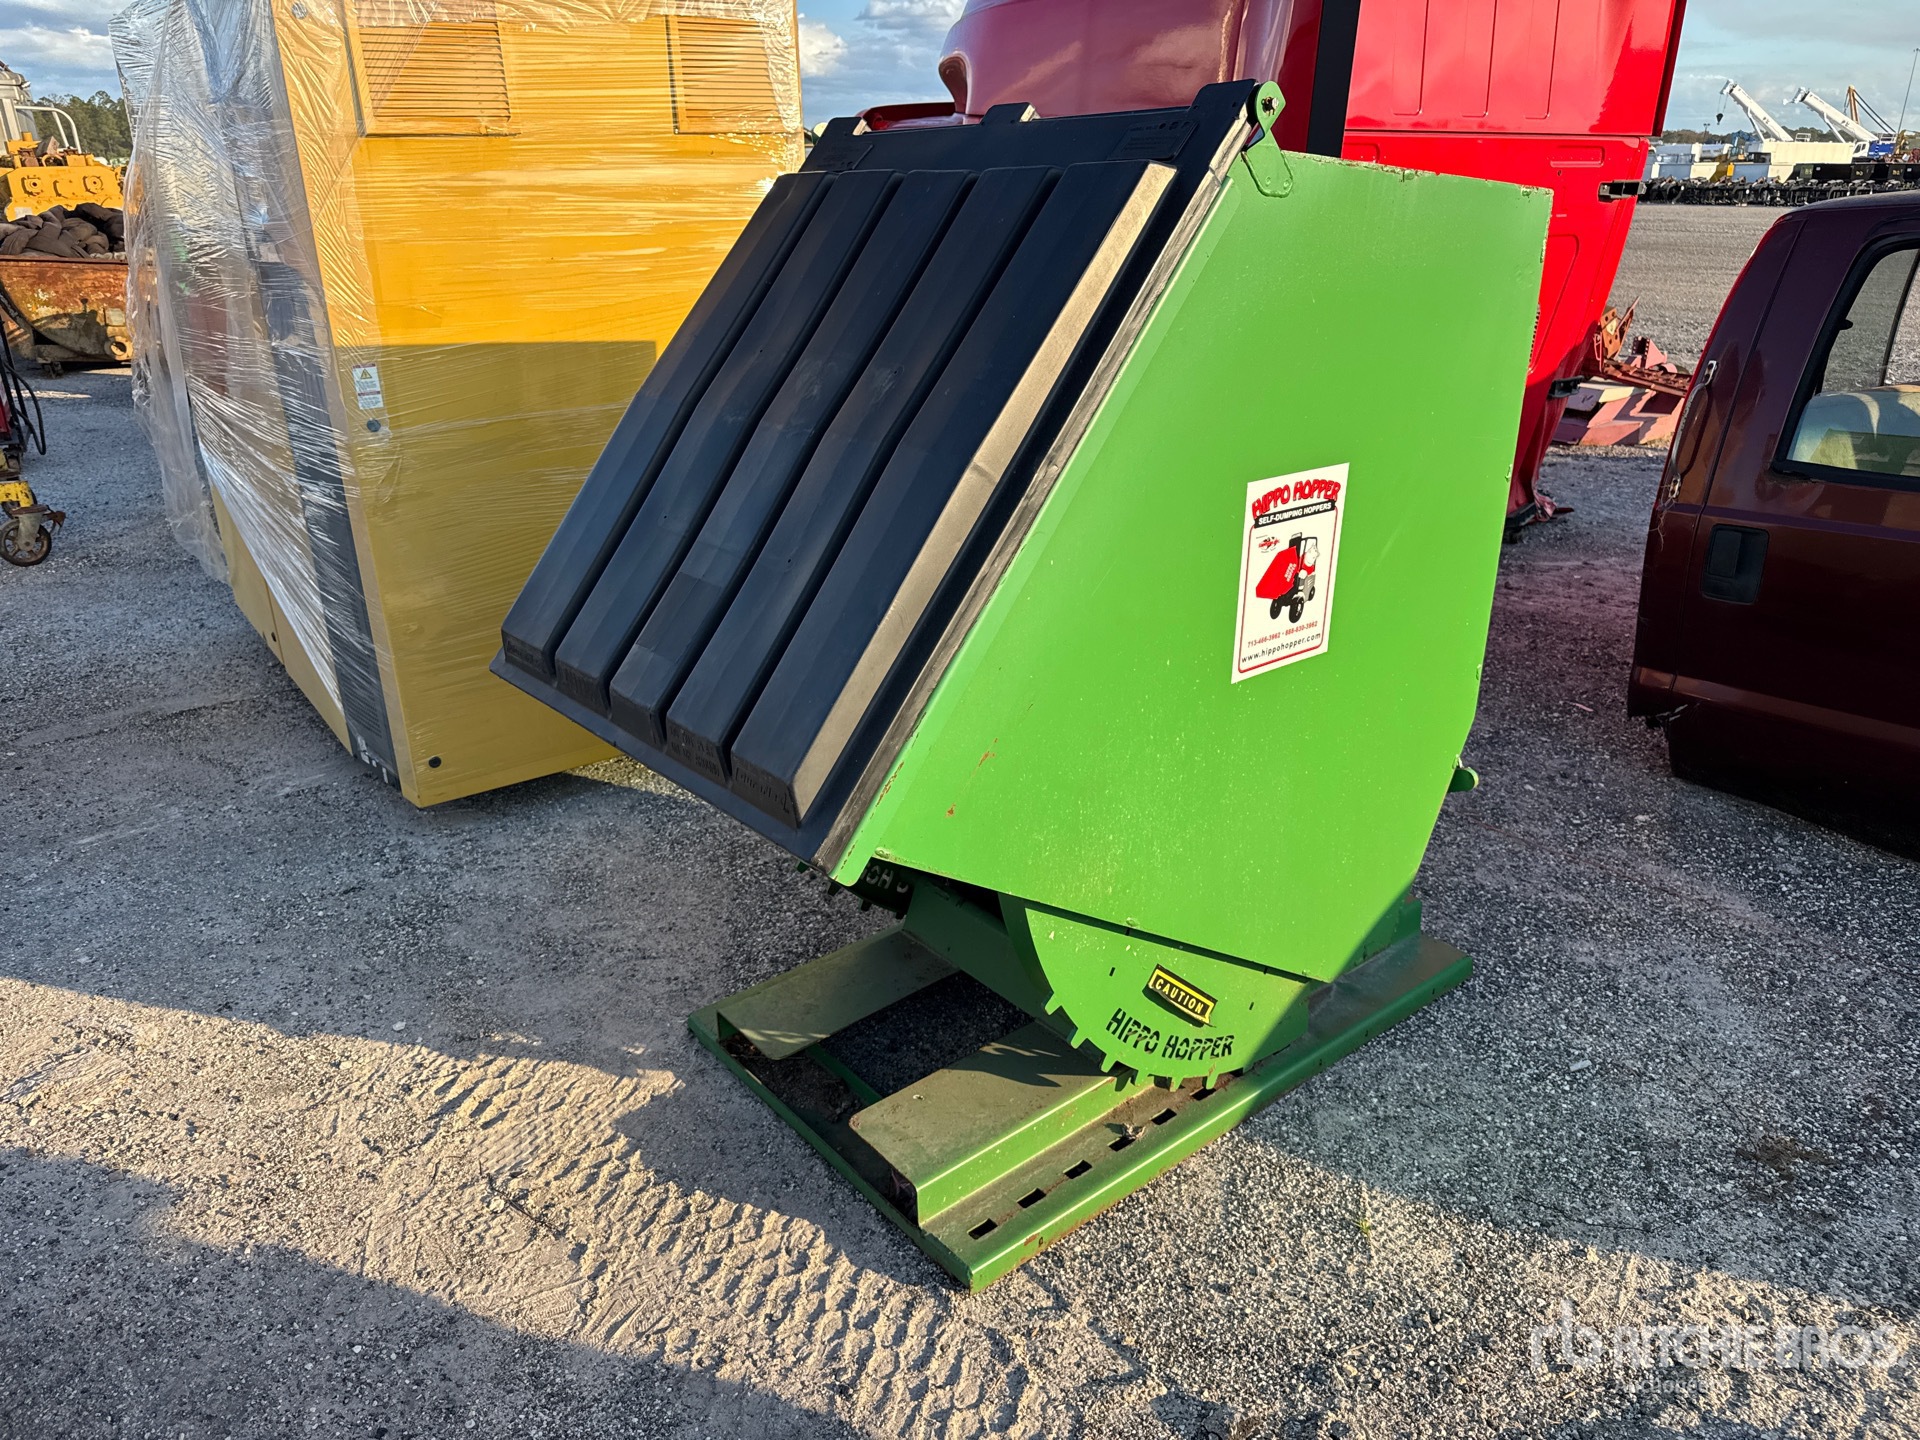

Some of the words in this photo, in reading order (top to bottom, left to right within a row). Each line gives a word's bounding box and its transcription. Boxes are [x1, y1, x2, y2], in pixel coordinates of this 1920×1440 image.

[1252, 484, 1290, 519] HIPPO
[1293, 479, 1341, 503] HOPPER
[1258, 508, 1303, 525] SELF-DUMPING
[1303, 502, 1332, 515] HOPPERS
[1241, 632, 1321, 663] www.hippohopper.com
[1155, 978, 1204, 1014] CAUTION
[1105, 1007, 1160, 1055] HIPPO
[1161, 1034, 1235, 1061] HOPPER
